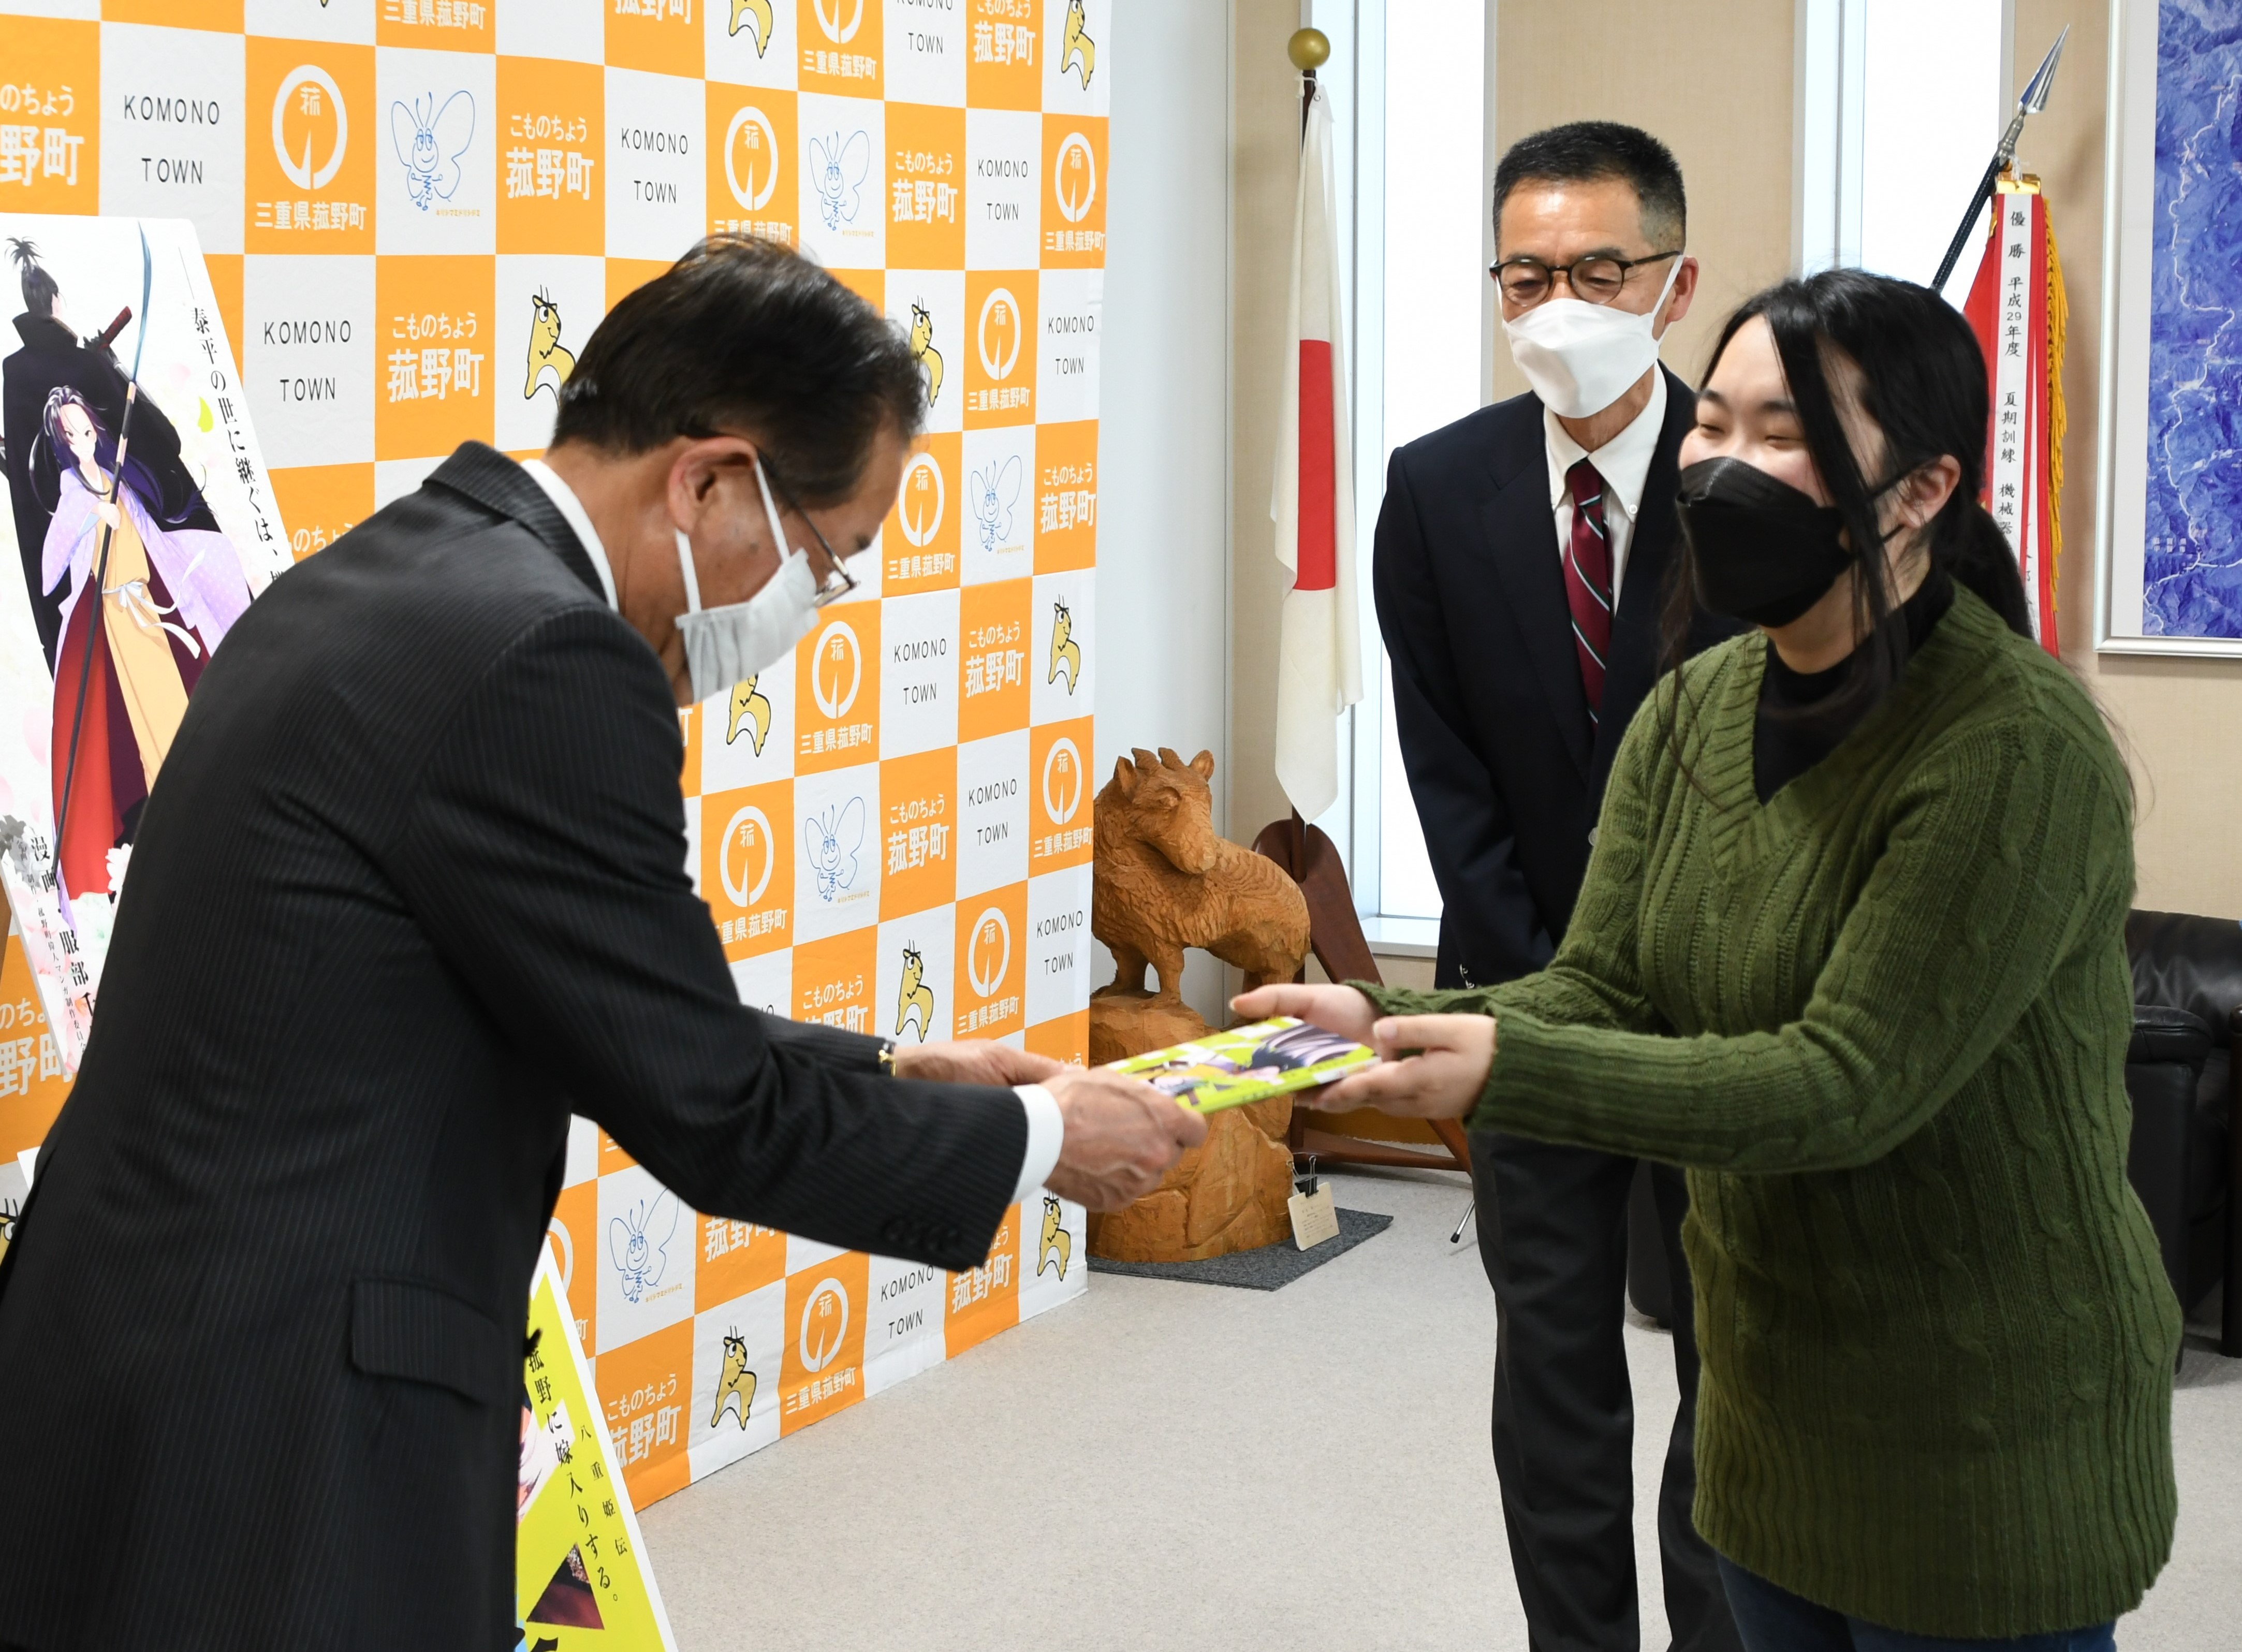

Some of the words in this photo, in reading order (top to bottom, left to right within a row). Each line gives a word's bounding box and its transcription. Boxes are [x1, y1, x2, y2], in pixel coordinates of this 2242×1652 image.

[907, 32, 943, 54] TOWN
[973, 20, 1036, 66] 菰野町
[803, 50, 877, 80] 三重県菰野町
[124, 95, 219, 125] KOMONO
[510, 113, 587, 142] こものちょう
[621, 127, 688, 155] KOMONO
[141, 157, 202, 184] TOWN
[506, 147, 594, 200] 菰野町
[896, 151, 953, 175] こものちょう
[978, 159, 1028, 178] KOMONO
[633, 180, 677, 204] TOWN
[892, 178, 958, 224] 菰野町
[255, 201, 367, 231] 三重県菰野町
[986, 202, 1019, 221] TOWN
[393, 312, 477, 340] こものちょう
[1048, 315, 1094, 334] KOMONO
[2005, 276, 2023, 357] 平成29年度
[264, 320, 351, 345] KOMONO
[387, 348, 485, 403] 菰野町
[1055, 357, 1084, 375] TOWN
[279, 377, 335, 402] TOWN
[968, 387, 1030, 411] 三重県菰野町
[191, 308, 284, 582] 泰平の世に継ぐは、
[1044, 463, 1093, 486] こものちょう
[1040, 490, 1096, 534] 菰野町
[888, 552, 955, 579] 三重県菰野町
[969, 621, 1020, 648] こものちょう
[894, 638, 947, 663] KOMONO
[965, 649, 1024, 698] 菰野町
[903, 682, 937, 705] TOWN
[800, 723, 873, 754] 三重県菰野町
[969, 778, 1017, 807] KOMONO
[890, 794, 944, 824] こものちょう
[977, 822, 1008, 846] TOWN
[887, 823, 949, 875] 菰野町
[1036, 910, 1083, 939] KOMONO
[1044, 952, 1073, 975] TOWN
[803, 975, 863, 1010] こものちょう
[957, 996, 1019, 1034] 三重県菰野町
[881, 1265, 934, 1302] KOMONO
[888, 1309, 923, 1339] TOWN
[608, 1373, 676, 1421] こものちょう
[786, 1368, 855, 1414] 三重県菰野町
